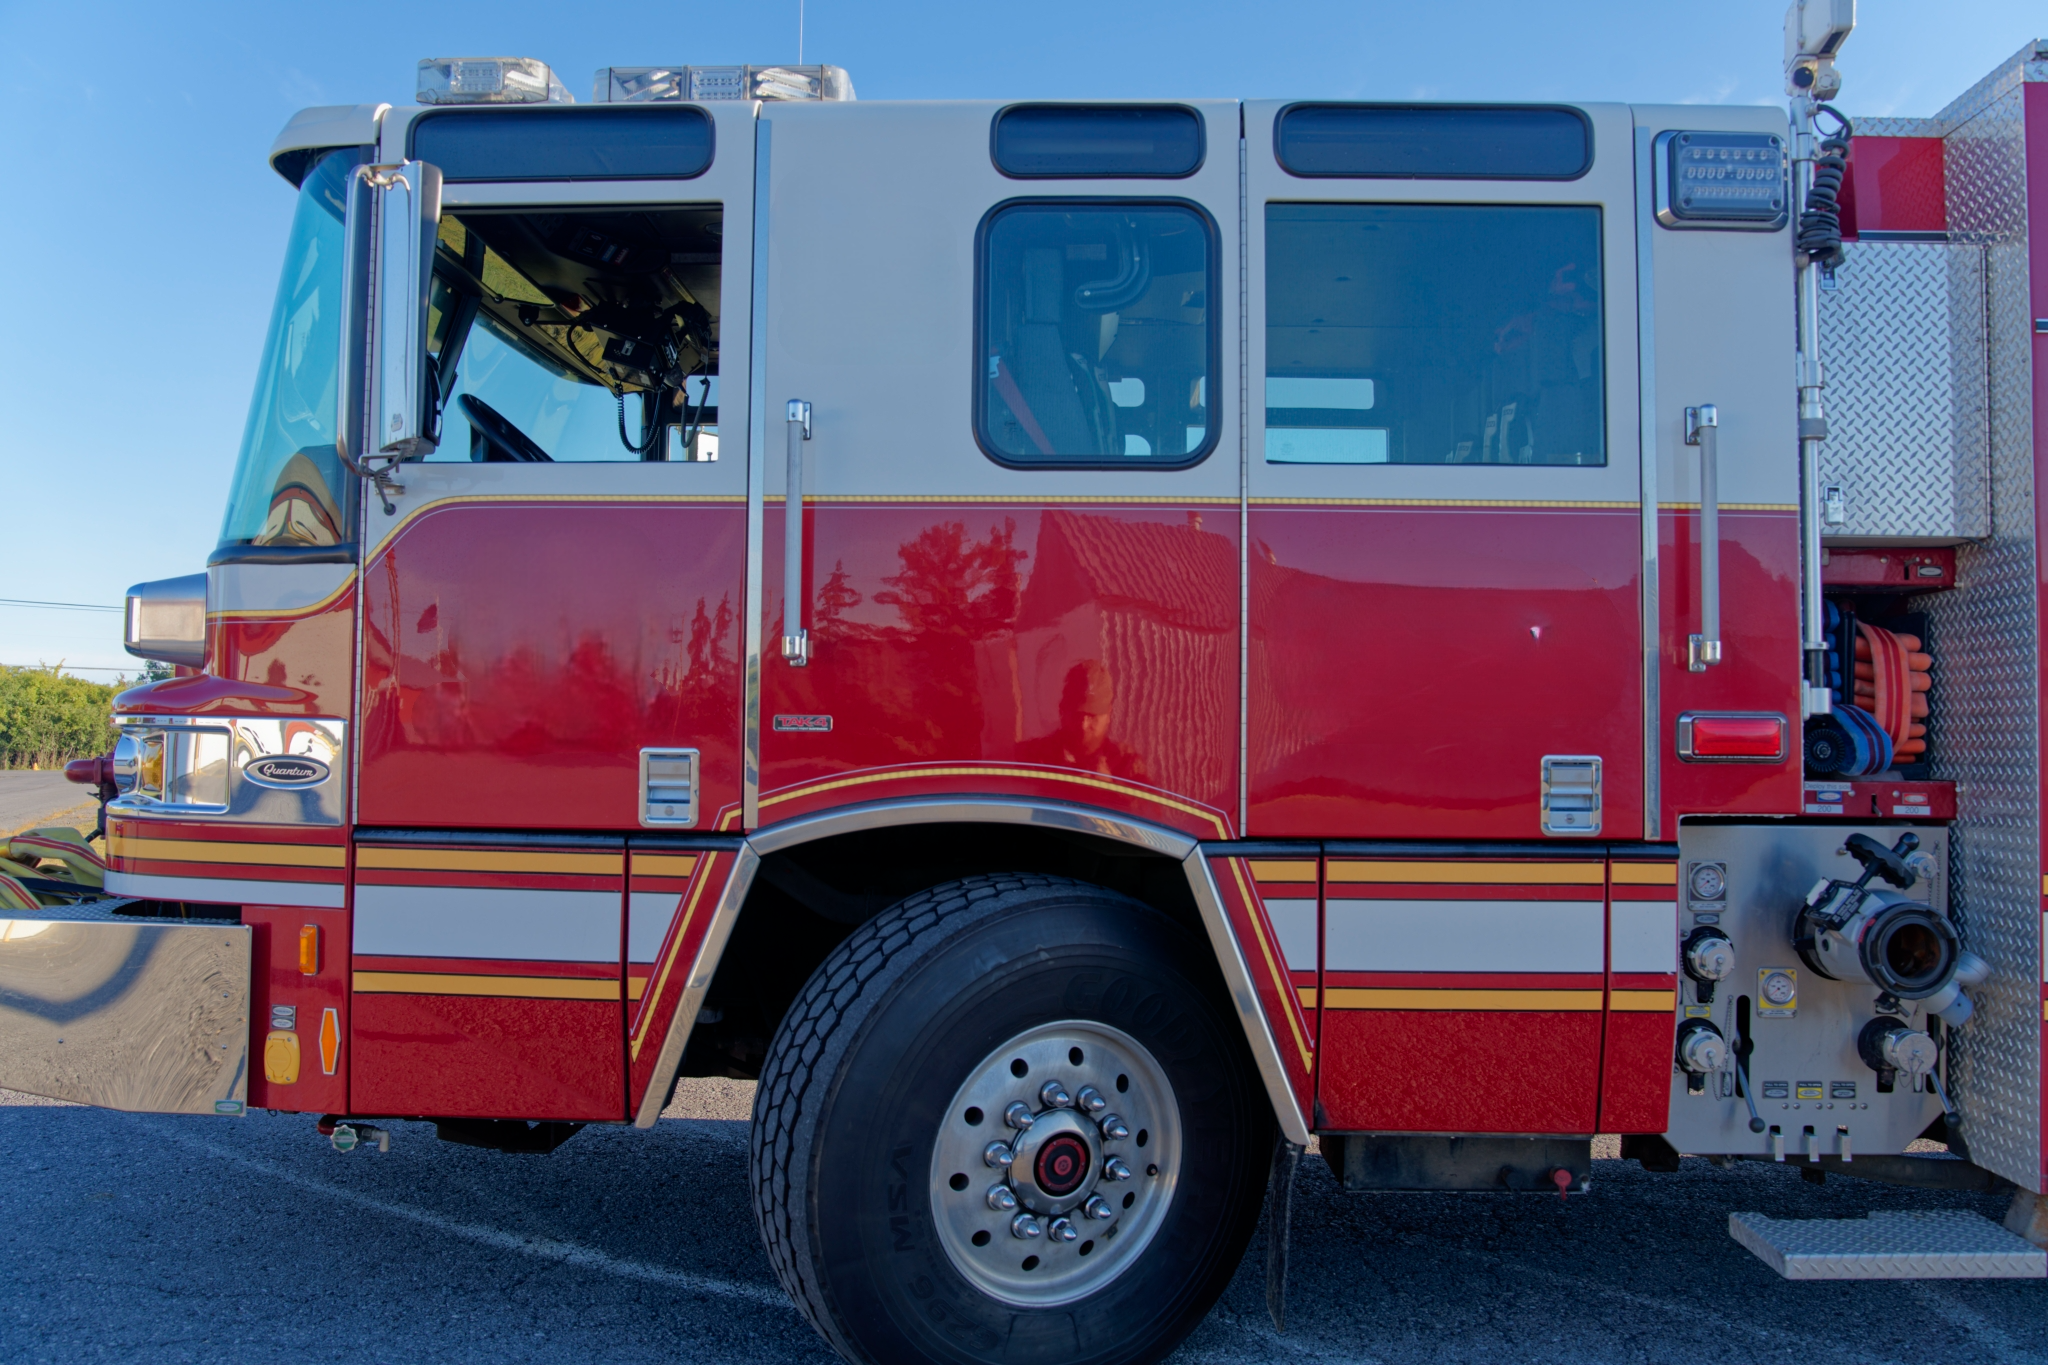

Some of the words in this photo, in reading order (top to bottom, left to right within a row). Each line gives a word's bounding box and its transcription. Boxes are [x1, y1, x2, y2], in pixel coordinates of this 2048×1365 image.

[263, 763, 314, 777] Quantum
[1805, 782, 1825, 790] Deploy
[1817, 805, 1832, 813] 200
[1905, 806, 1919, 814] 200
